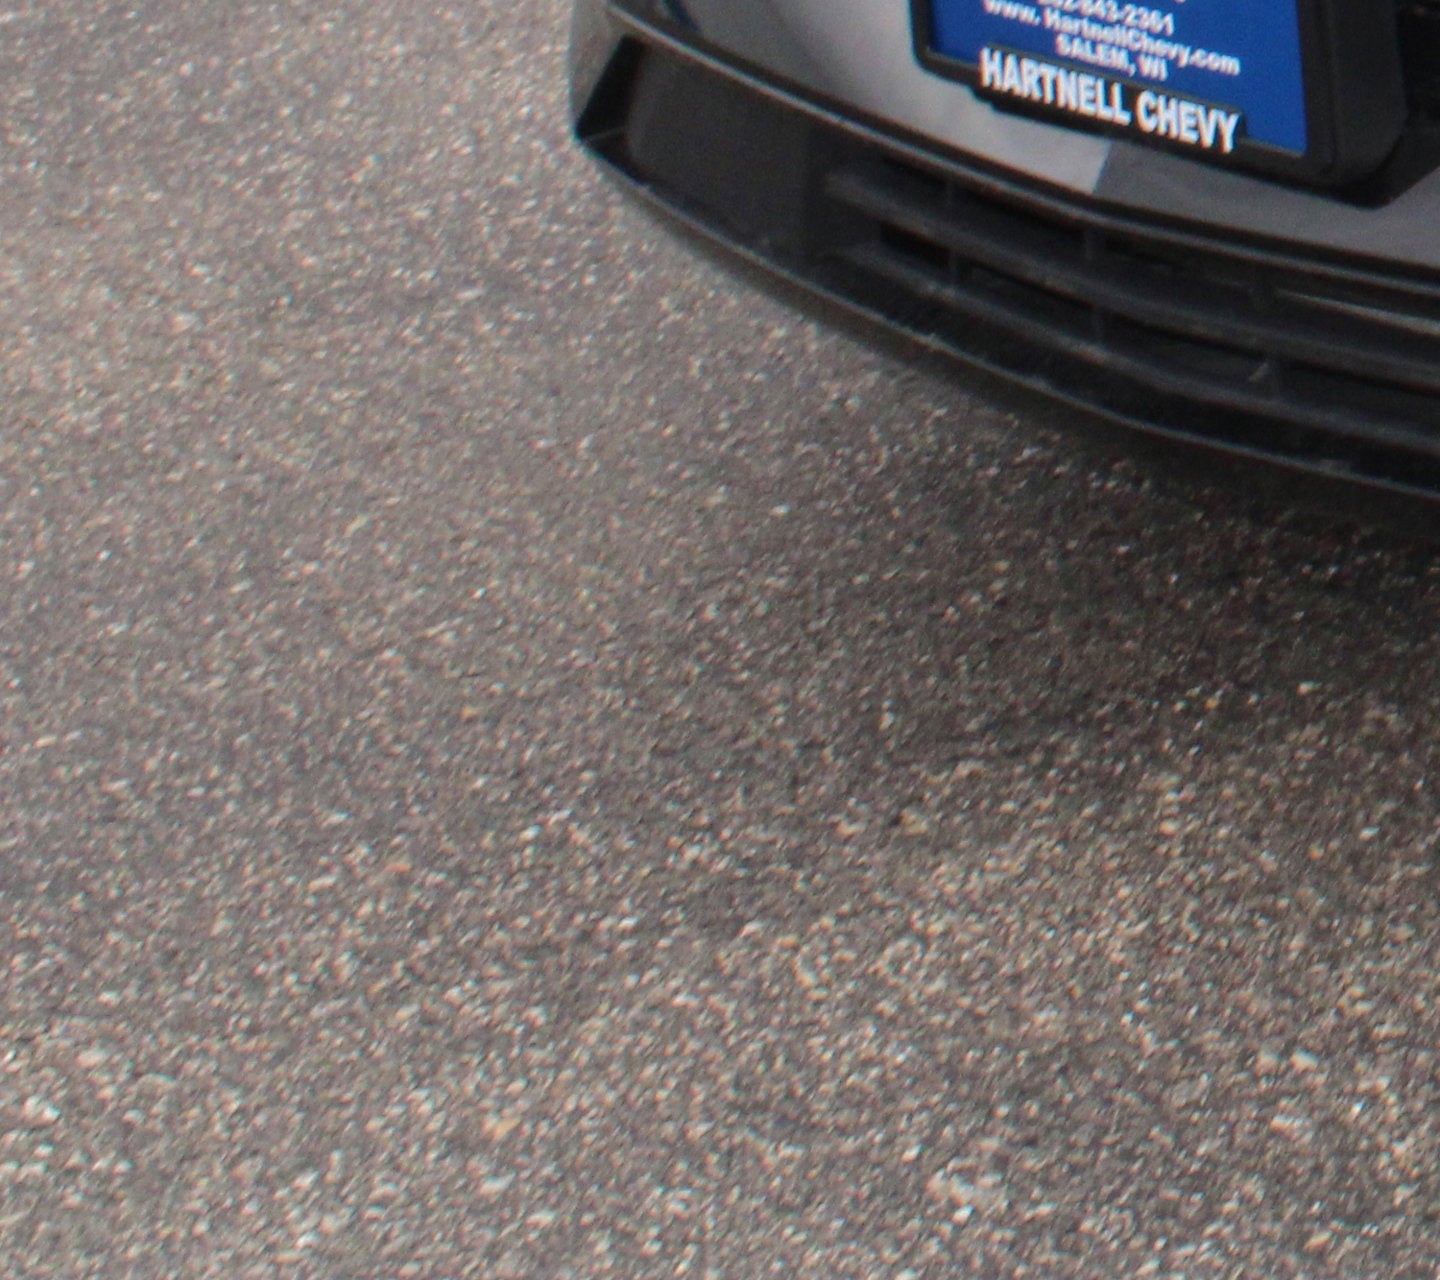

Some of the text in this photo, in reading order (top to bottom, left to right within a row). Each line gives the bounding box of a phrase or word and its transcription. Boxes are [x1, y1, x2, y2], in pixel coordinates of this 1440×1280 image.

[1056, 33, 1169, 81] SALEM, WI
[978, 46, 1241, 154] HARTNELL CHEVY
